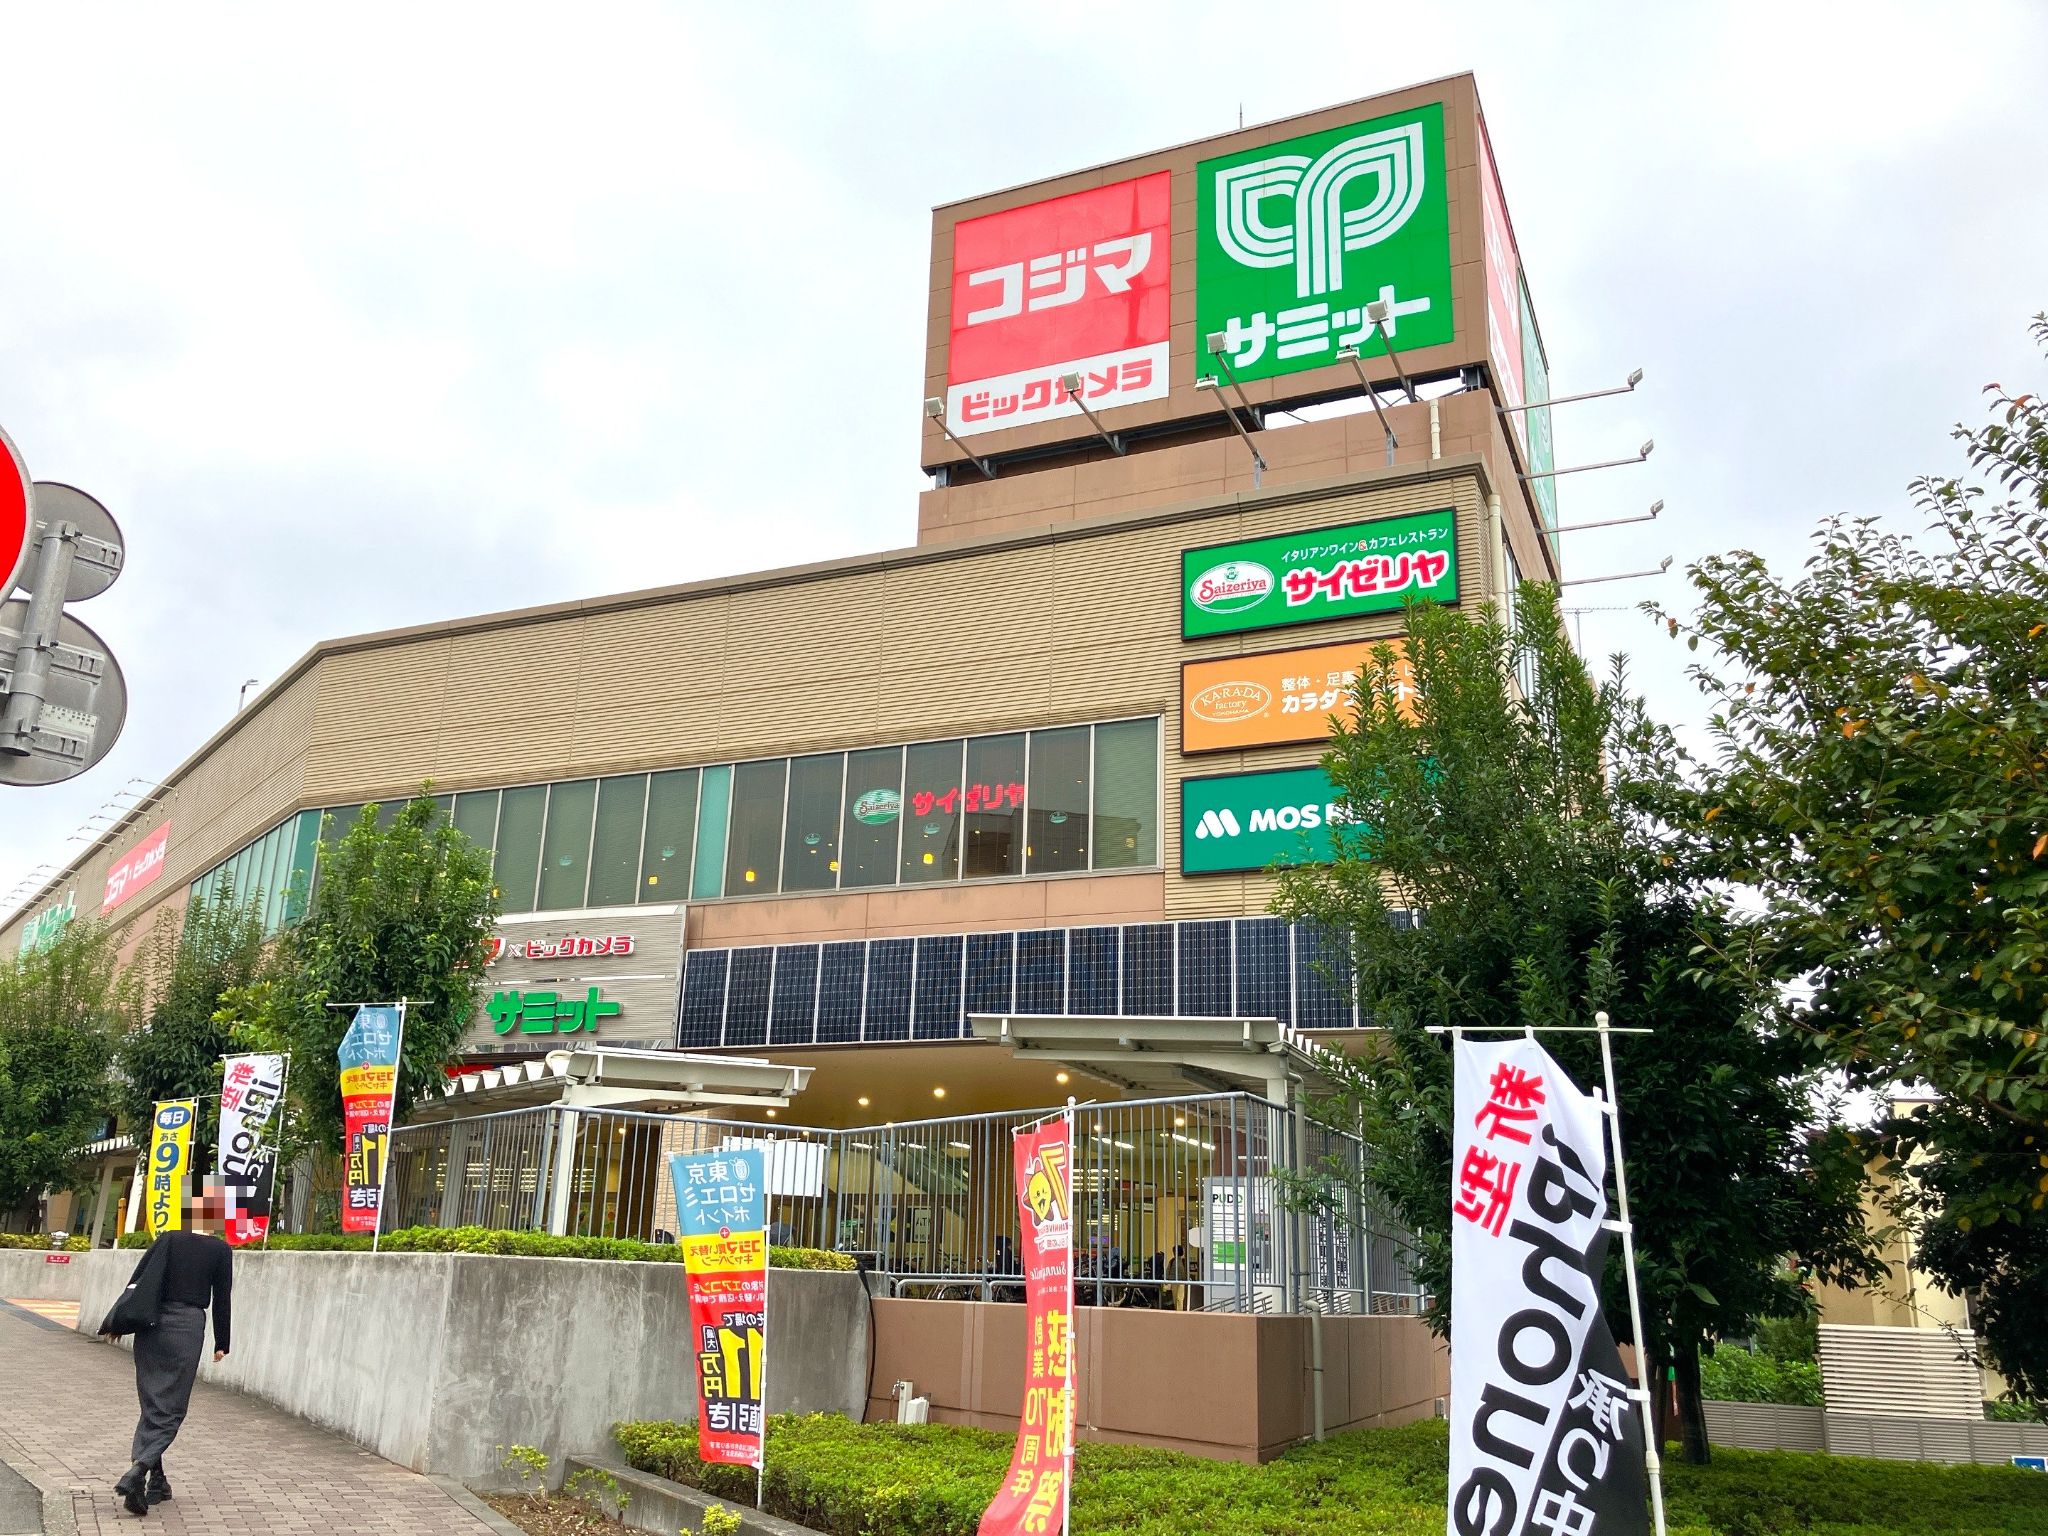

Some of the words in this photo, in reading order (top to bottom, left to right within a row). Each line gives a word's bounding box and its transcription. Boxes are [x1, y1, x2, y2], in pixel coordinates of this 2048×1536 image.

[967, 232, 1153, 326] コジマ
[1227, 285, 1431, 368] サミット
[962, 359, 1154, 423] ビックカメラ
[1197, 578, 1267, 602] Saizeriya
[1283, 550, 1449, 606] サイゼリヤ
[912, 783, 1026, 817] サイゼリヤ
[1249, 804, 1322, 833] MOS
[525, 935, 635, 959] ビックカメラ
[486, 986, 623, 1035] サミット
[159, 1110, 185, 1125] 毎日
[159, 1132, 179, 1142] あさ
[153, 1143, 180, 1238] 9時より
